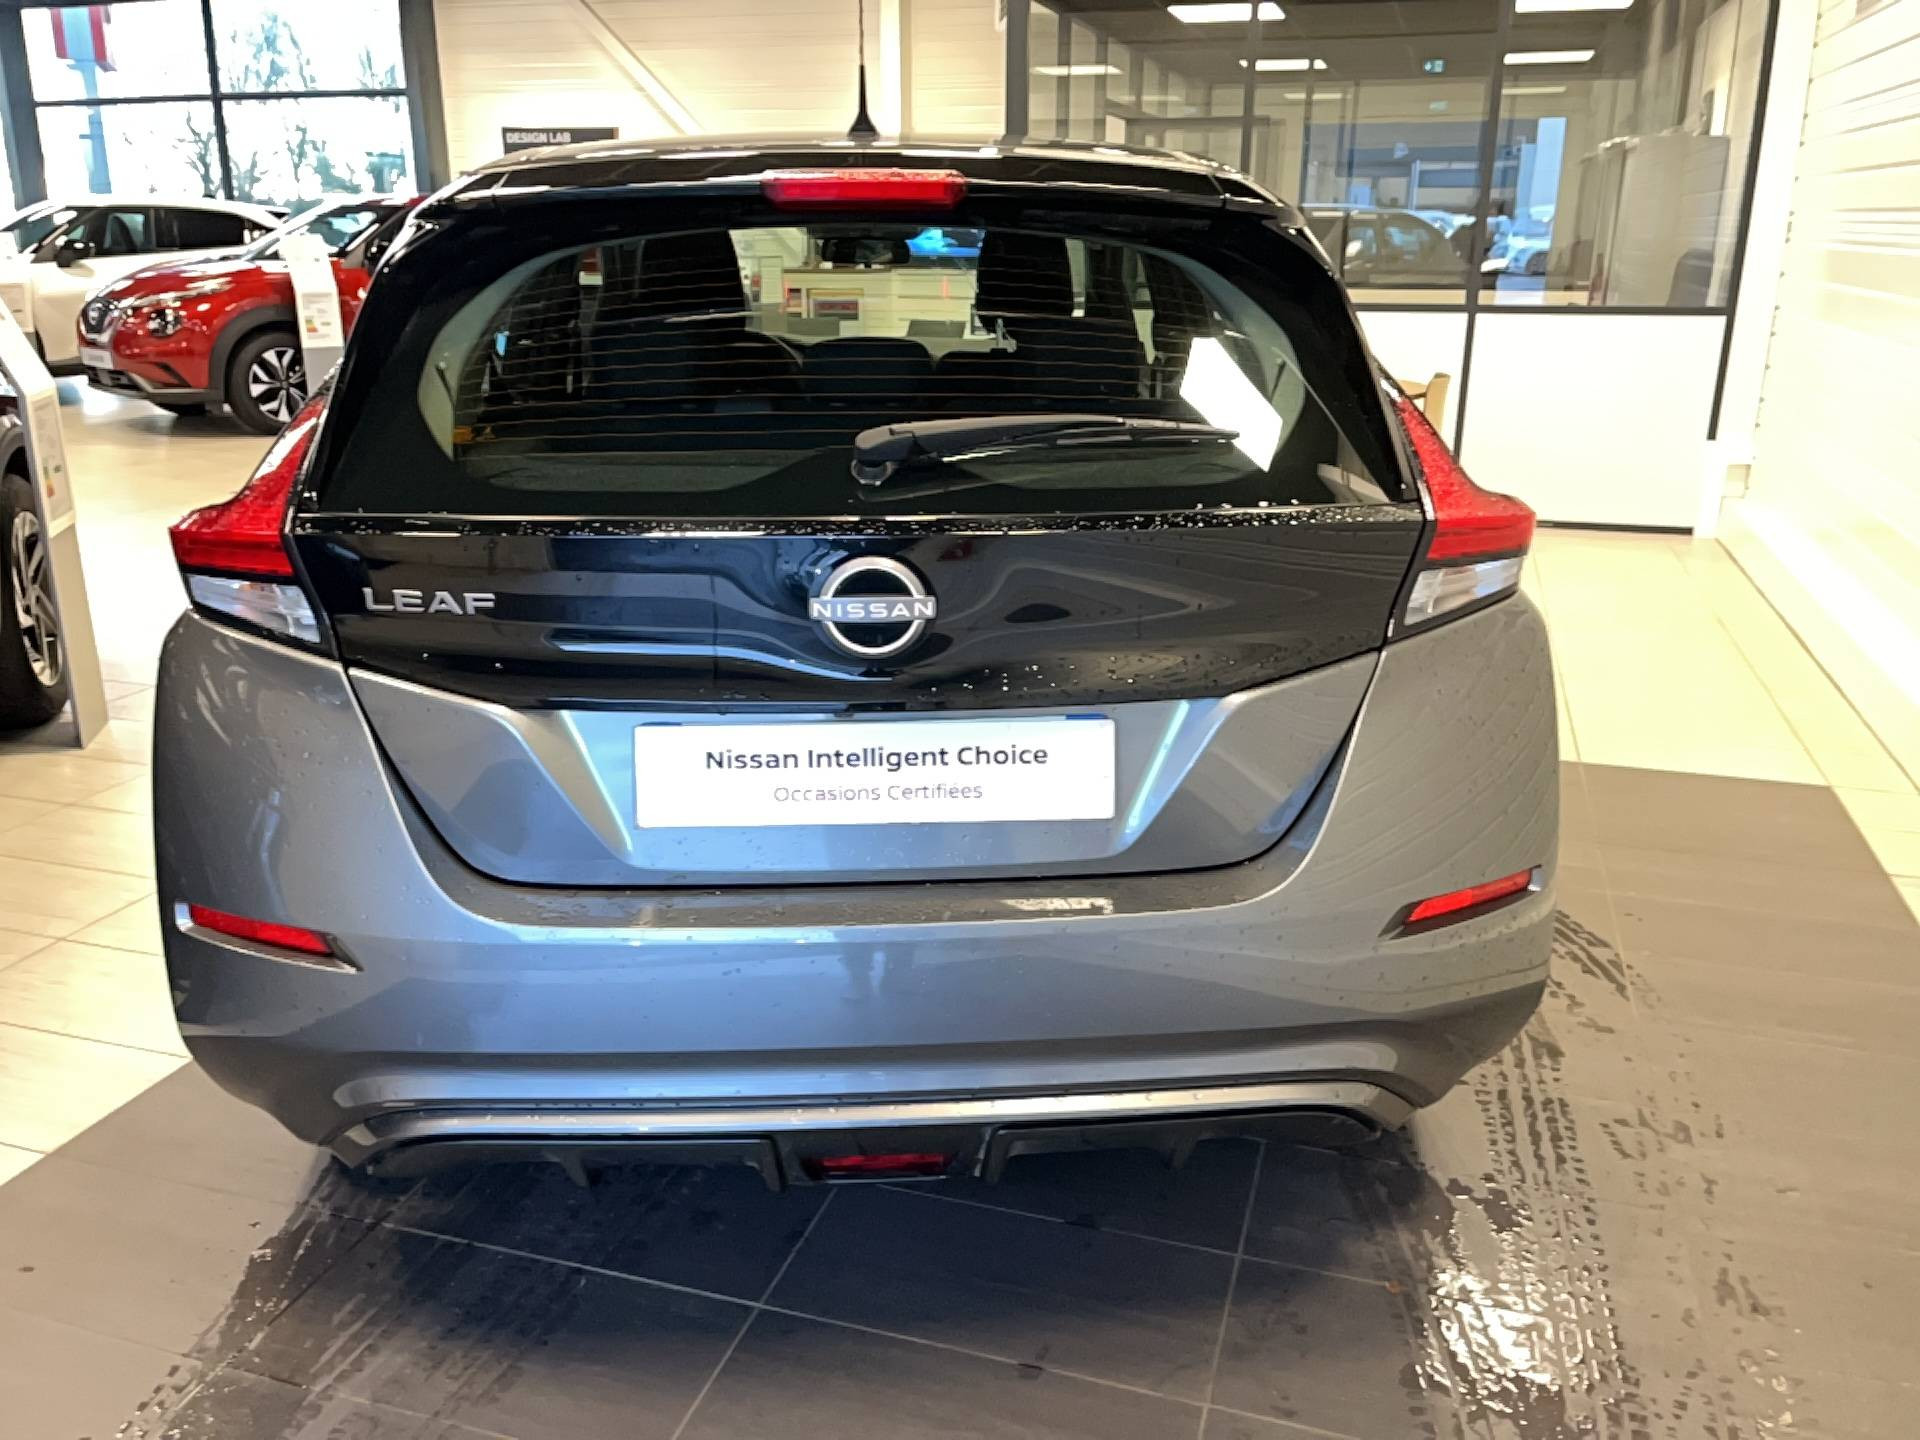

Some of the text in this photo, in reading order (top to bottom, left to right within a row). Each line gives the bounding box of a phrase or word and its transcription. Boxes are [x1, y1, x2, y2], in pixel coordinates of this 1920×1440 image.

[505, 131, 572, 144] DESIGN LAB
[361, 586, 496, 616] LEAF
[812, 601, 934, 618] NISSAN
[706, 744, 1048, 772] Nissan Intelligent Choice
[773, 783, 983, 801] Occasions Certifiées
